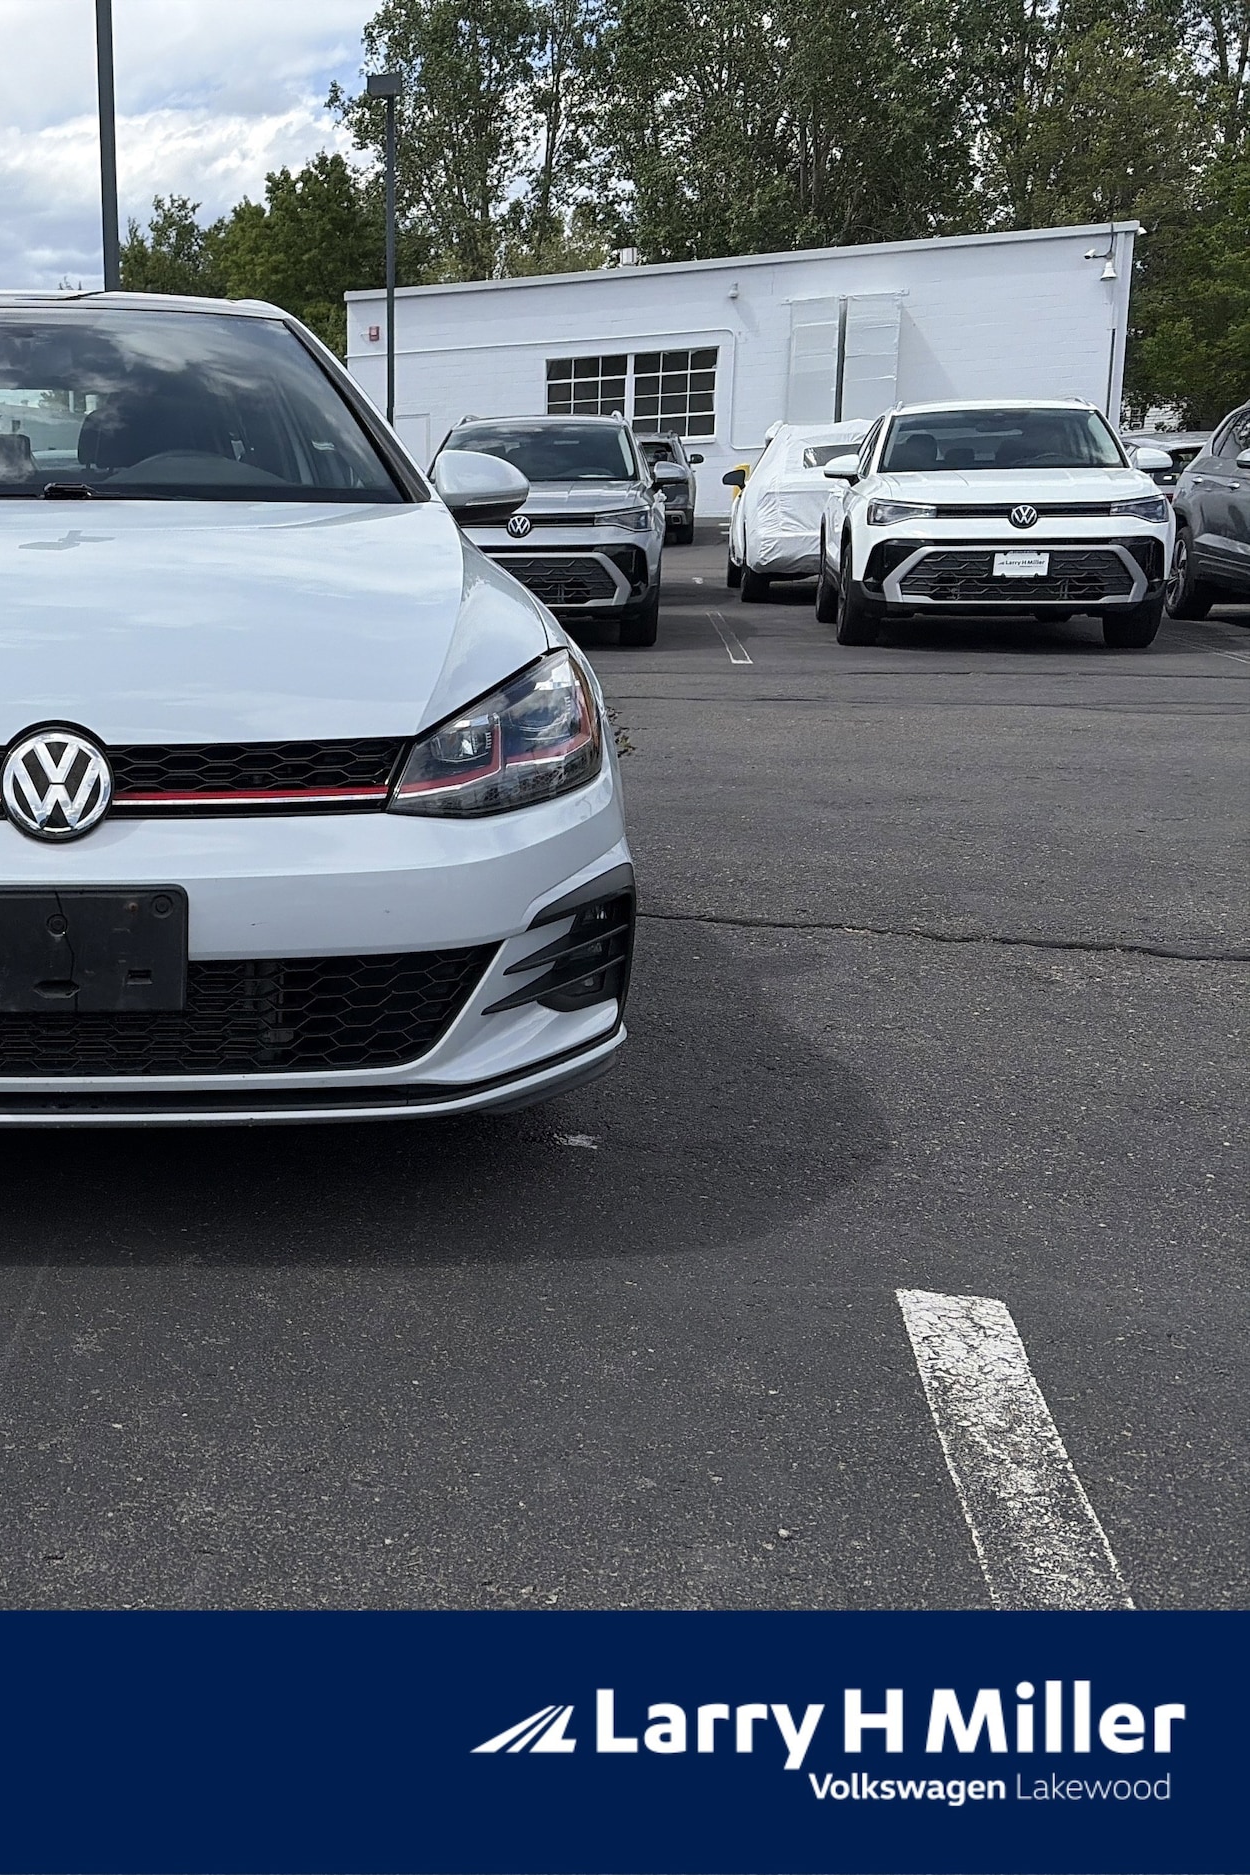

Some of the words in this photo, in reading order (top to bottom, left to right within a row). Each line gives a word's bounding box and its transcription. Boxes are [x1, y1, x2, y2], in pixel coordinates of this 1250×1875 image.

[508, 515, 530, 536] VW
[1011, 505, 1037, 527] VW
[3, 733, 111, 832] VW
